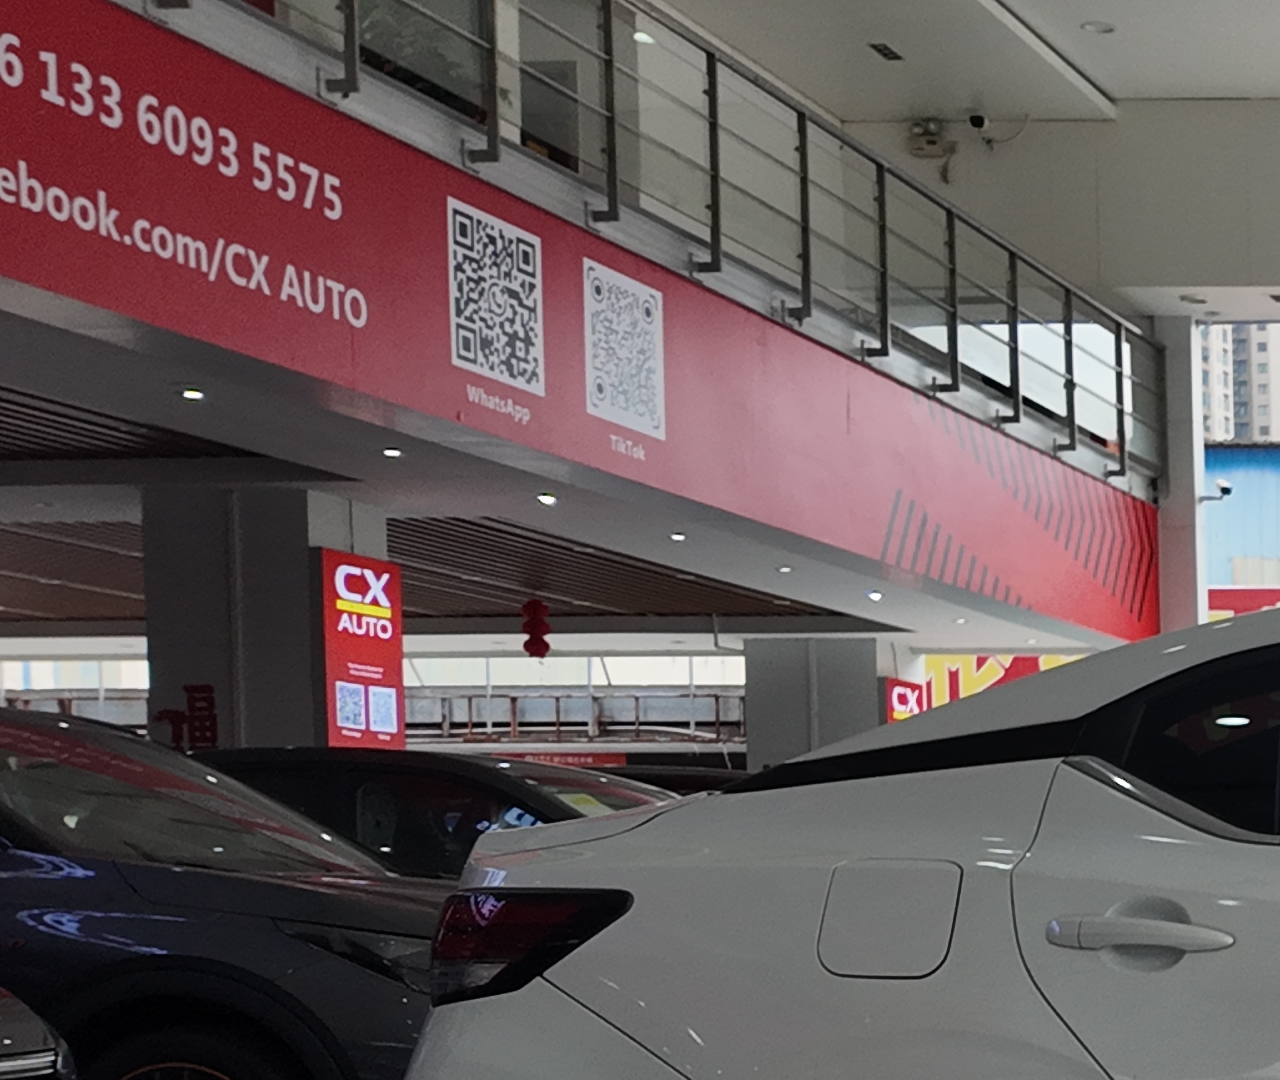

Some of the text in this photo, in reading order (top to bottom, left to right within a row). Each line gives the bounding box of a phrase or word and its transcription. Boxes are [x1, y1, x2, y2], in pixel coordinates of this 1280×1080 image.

[38, 50, 124, 129] 133
[137, 94, 239, 177] 6093
[252, 142, 343, 220] 5575
[0, 160, 368, 328] ebook.com/CX AUTO
[466, 384, 531, 425] WhatsApp
[609, 434, 646, 461] TikTok
[334, 564, 391, 608] CX
[337, 612, 392, 640] AUTO
[892, 685, 919, 715] CX
